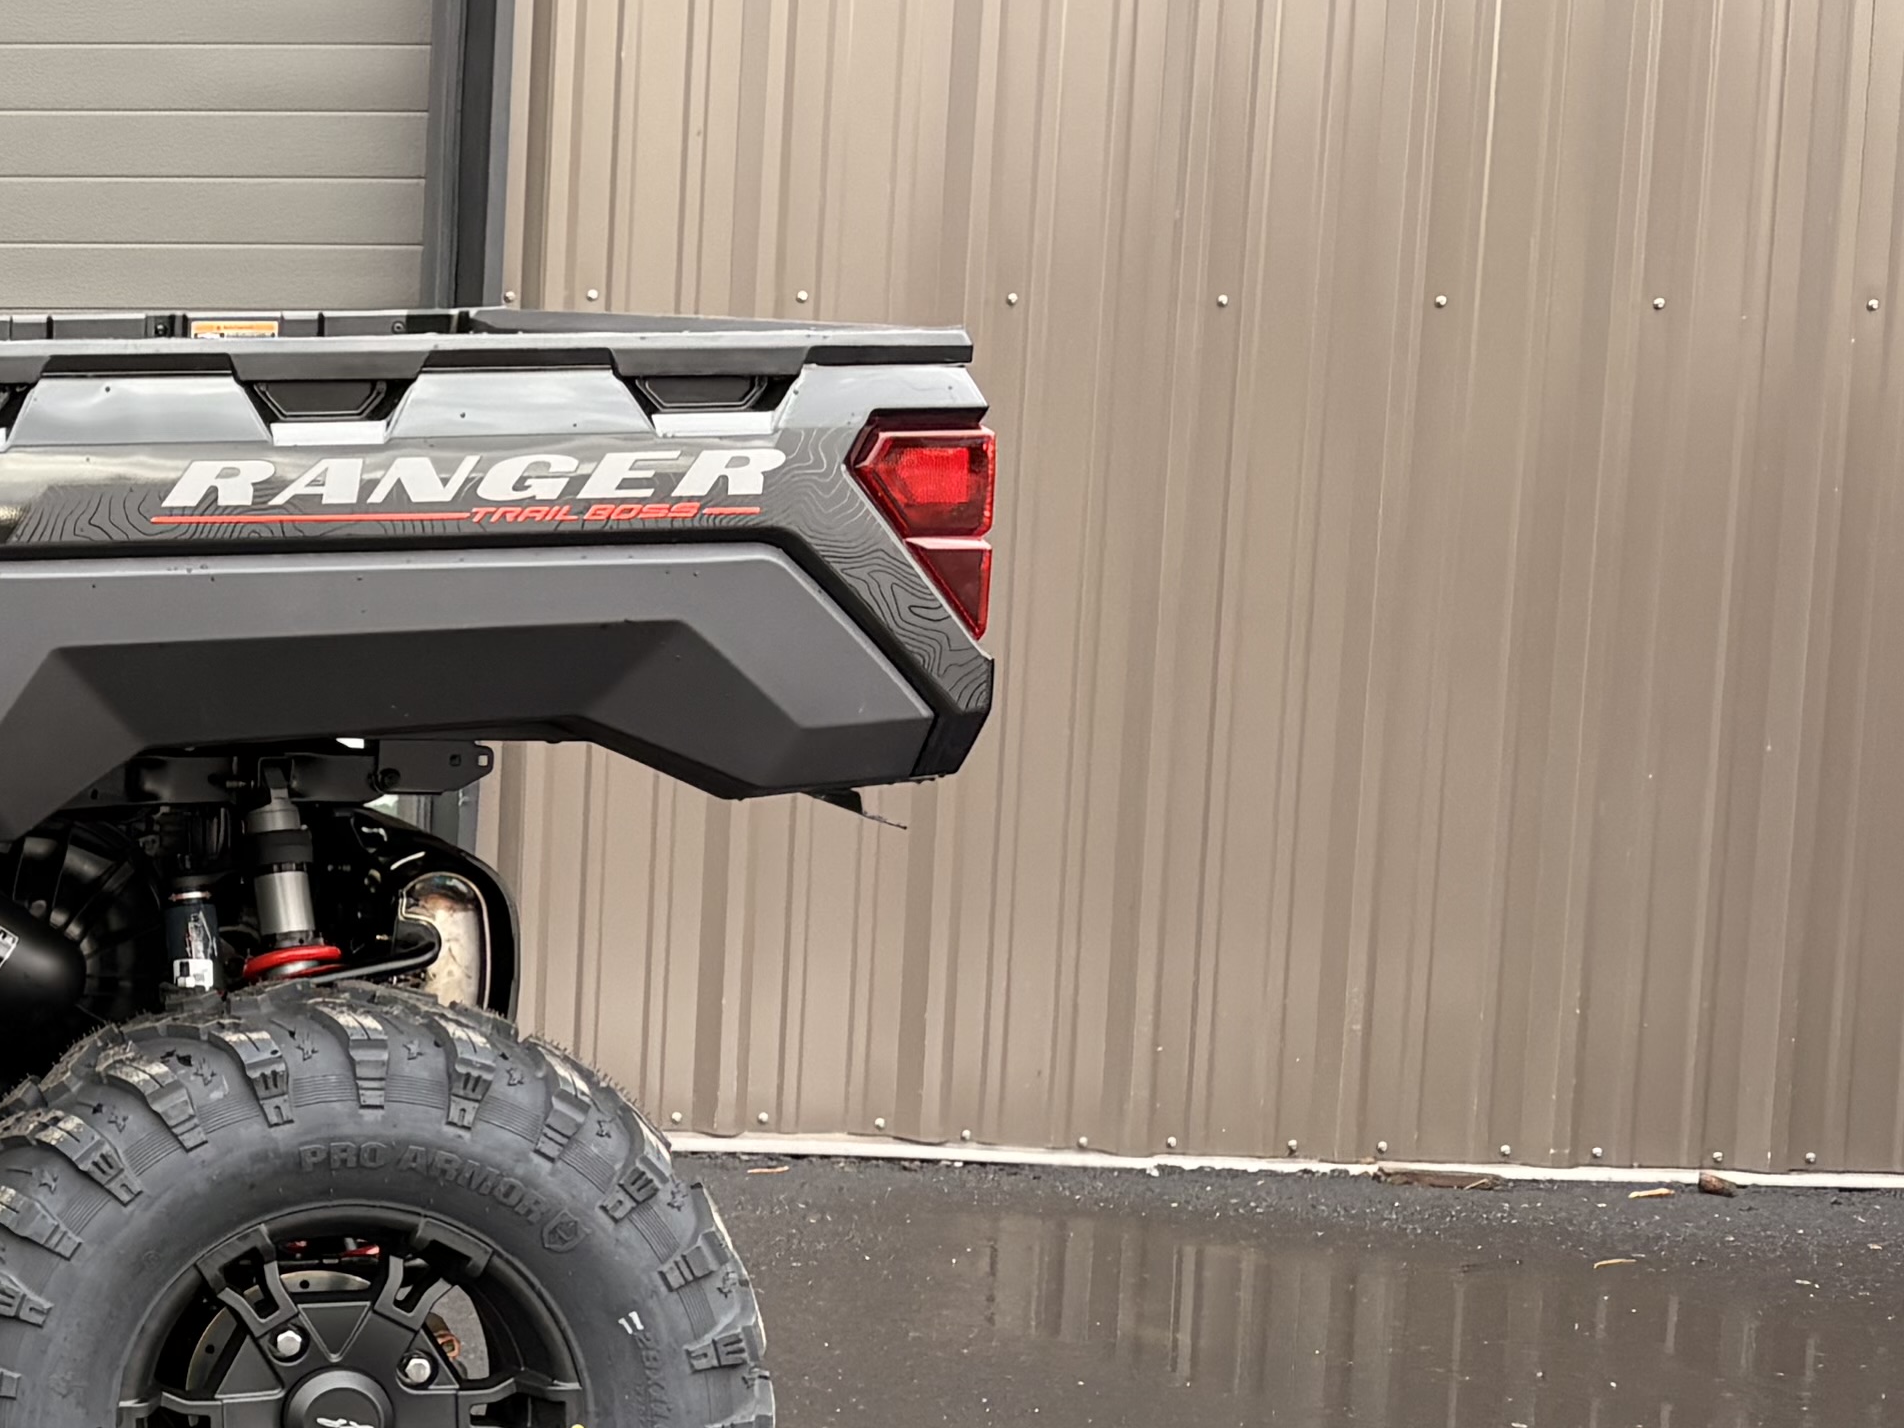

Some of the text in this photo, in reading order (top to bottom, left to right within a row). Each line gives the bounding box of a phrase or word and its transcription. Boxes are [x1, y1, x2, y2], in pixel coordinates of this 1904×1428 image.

[161, 448, 787, 509] RANGER
[470, 501, 700, 524] TRAIL BOSS
[298, 1140, 545, 1224] PRO ARMOR
